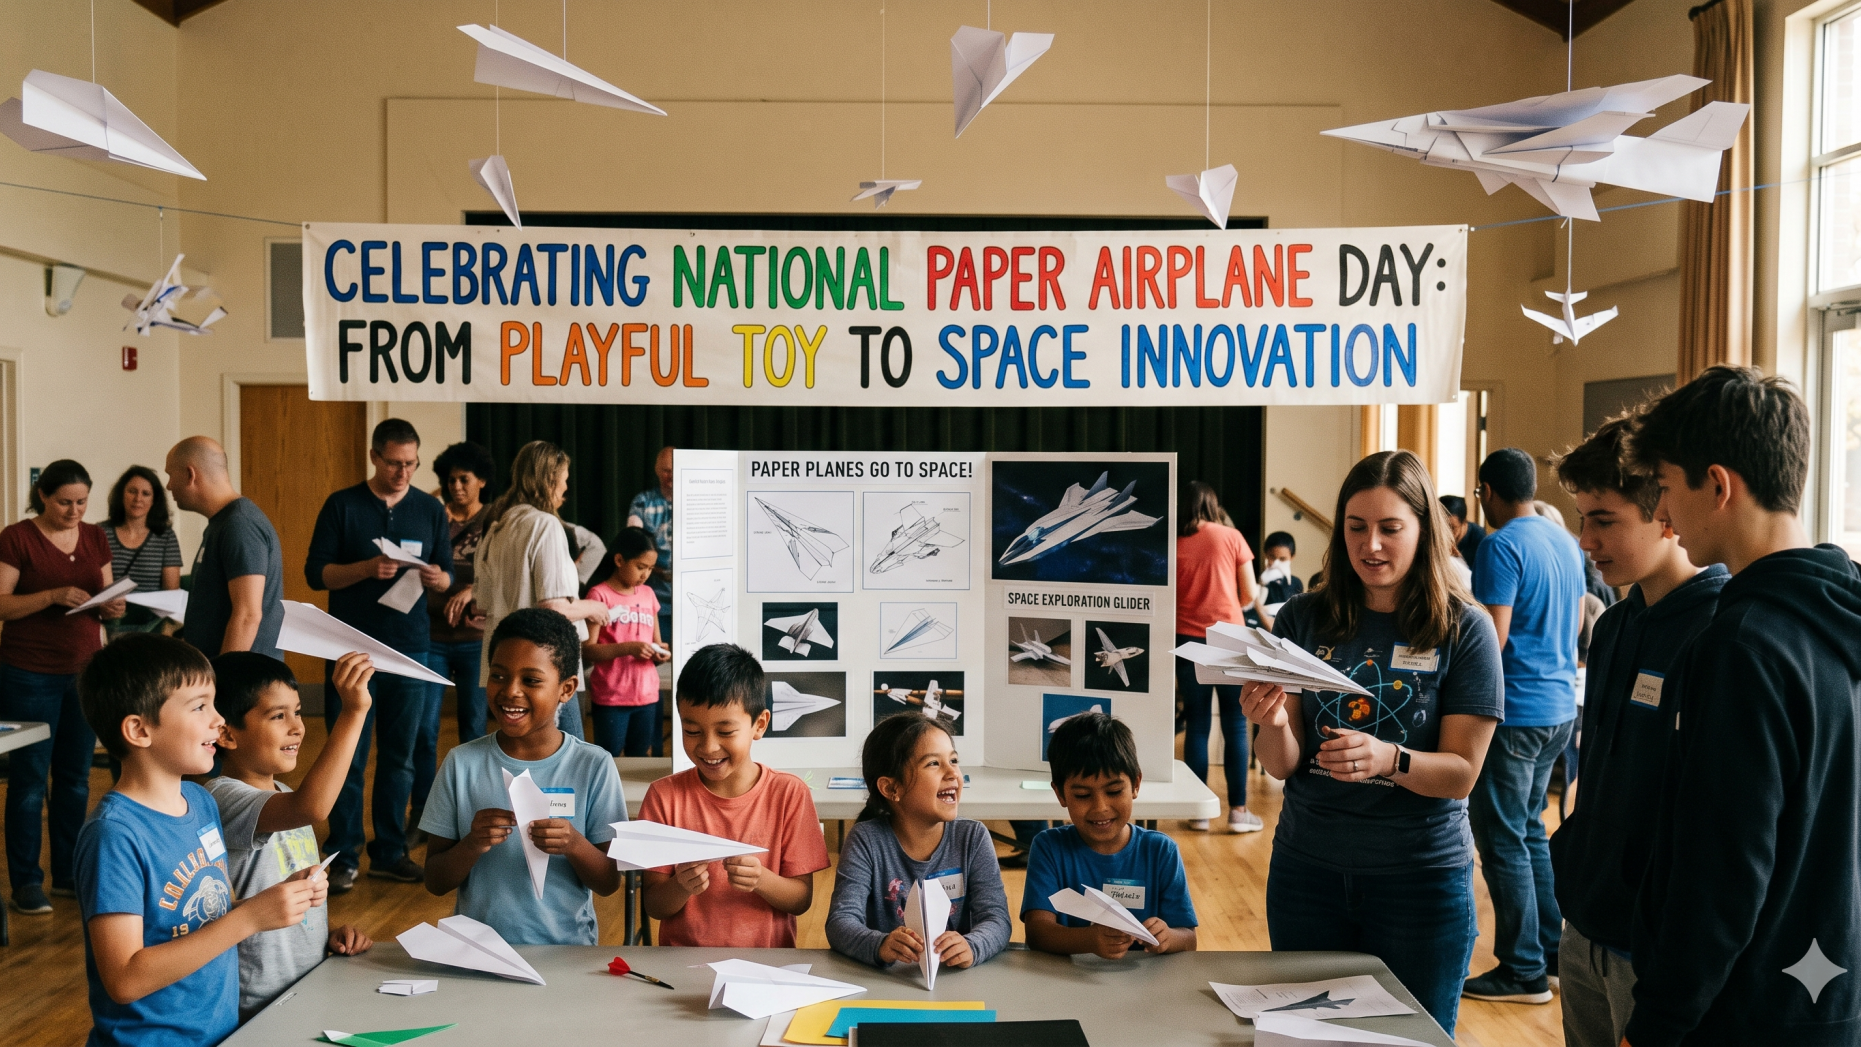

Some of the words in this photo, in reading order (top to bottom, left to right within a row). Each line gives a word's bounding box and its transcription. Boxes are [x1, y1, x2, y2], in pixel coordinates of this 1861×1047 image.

[325, 240, 649, 306] CELEBRATING
[674, 245, 904, 310] NATIONAL
[927, 245, 1066, 310] PAPER
[1089, 244, 1313, 310] AIRPLANE
[1339, 243, 1446, 307] DAY:
[339, 320, 471, 384] FROM
[500, 321, 709, 387] PLAYFUL
[732, 324, 828, 389] TOY
[848, 325, 913, 389] TO
[936, 324, 1091, 389] SPACE
[1121, 323, 1417, 389] INNOVATION
[751, 461, 800, 478] PAPER
[805, 461, 864, 478] PLANES
[870, 461, 890, 478] GO
[895, 461, 914, 478] TO
[919, 461, 973, 478] SPACE!
[1008, 592, 1040, 606] SPACE
[1042, 593, 1111, 609] EXPLORATION
[1113, 596, 1150, 611] GLIDER
